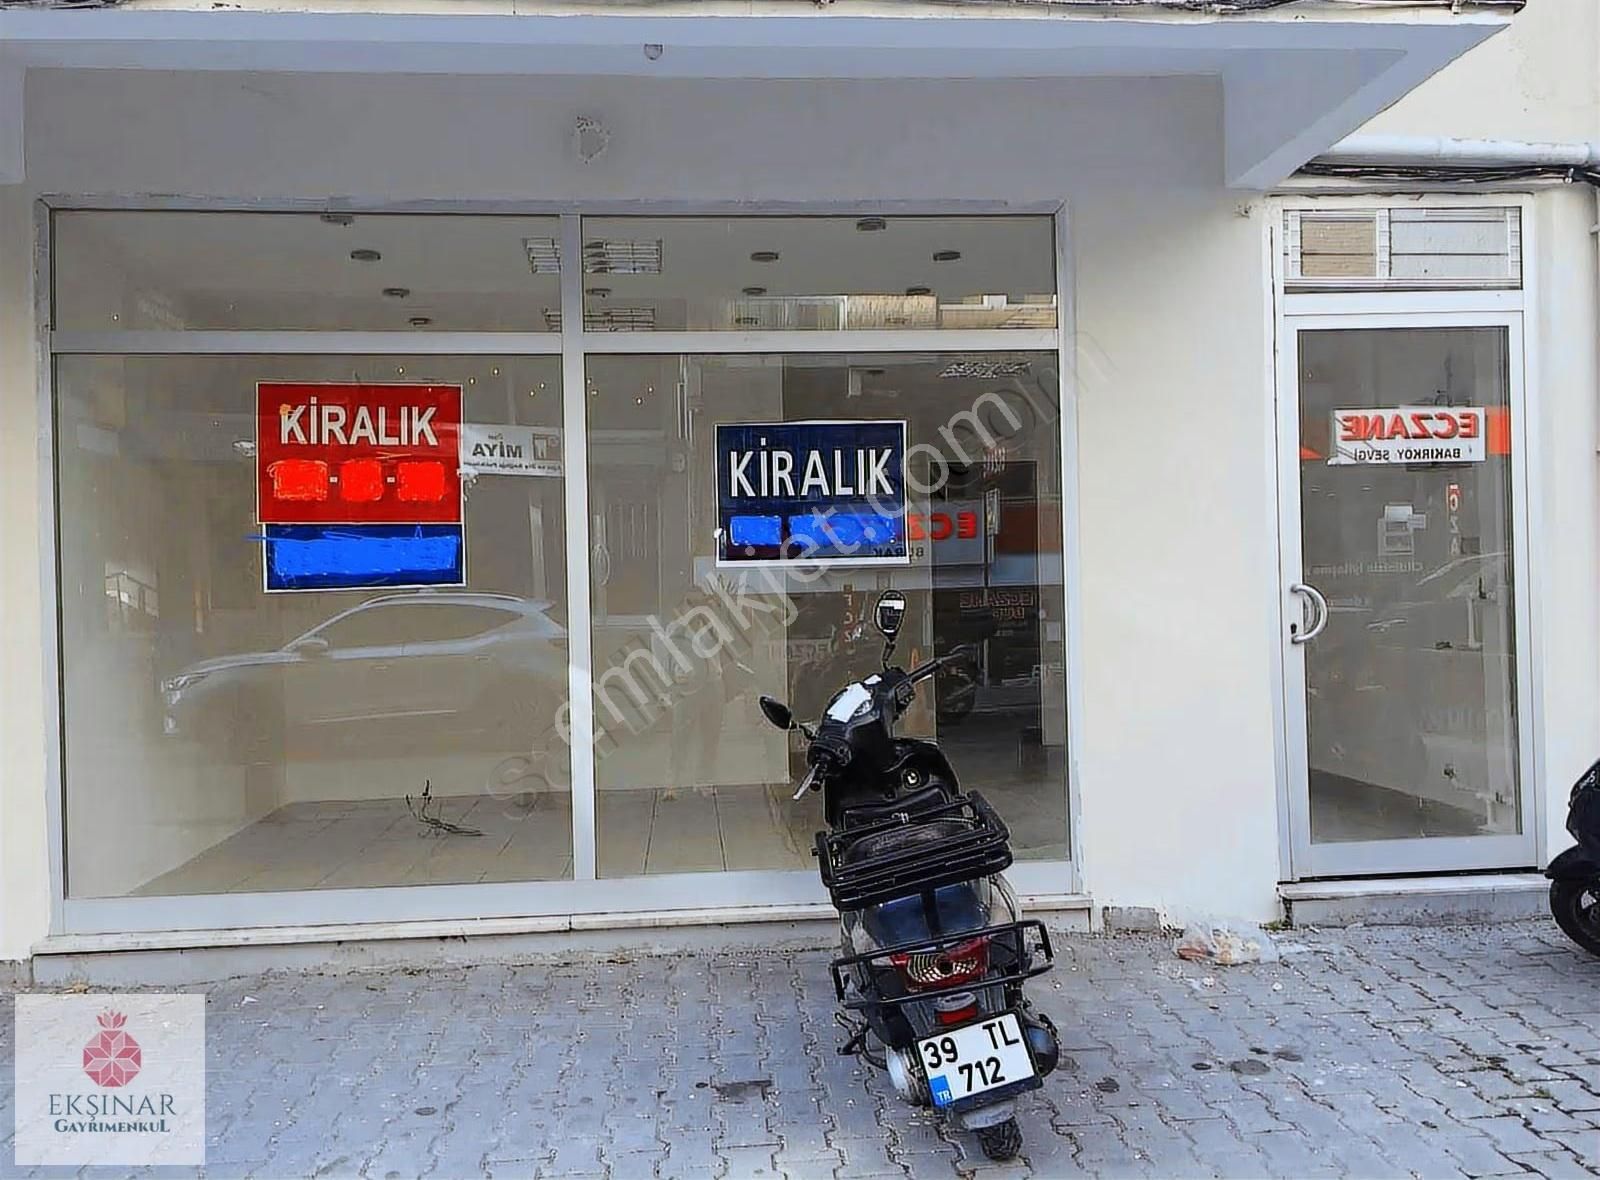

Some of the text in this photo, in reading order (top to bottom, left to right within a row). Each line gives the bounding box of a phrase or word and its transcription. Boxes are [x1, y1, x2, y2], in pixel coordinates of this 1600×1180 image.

[280, 396, 438, 446] KİRALIK
[730, 437, 894, 497] KİRALIK
[923, 1021, 1019, 1068] 39 TL
[936, 1090, 952, 1102] TR
[958, 1057, 1005, 1092] 712
